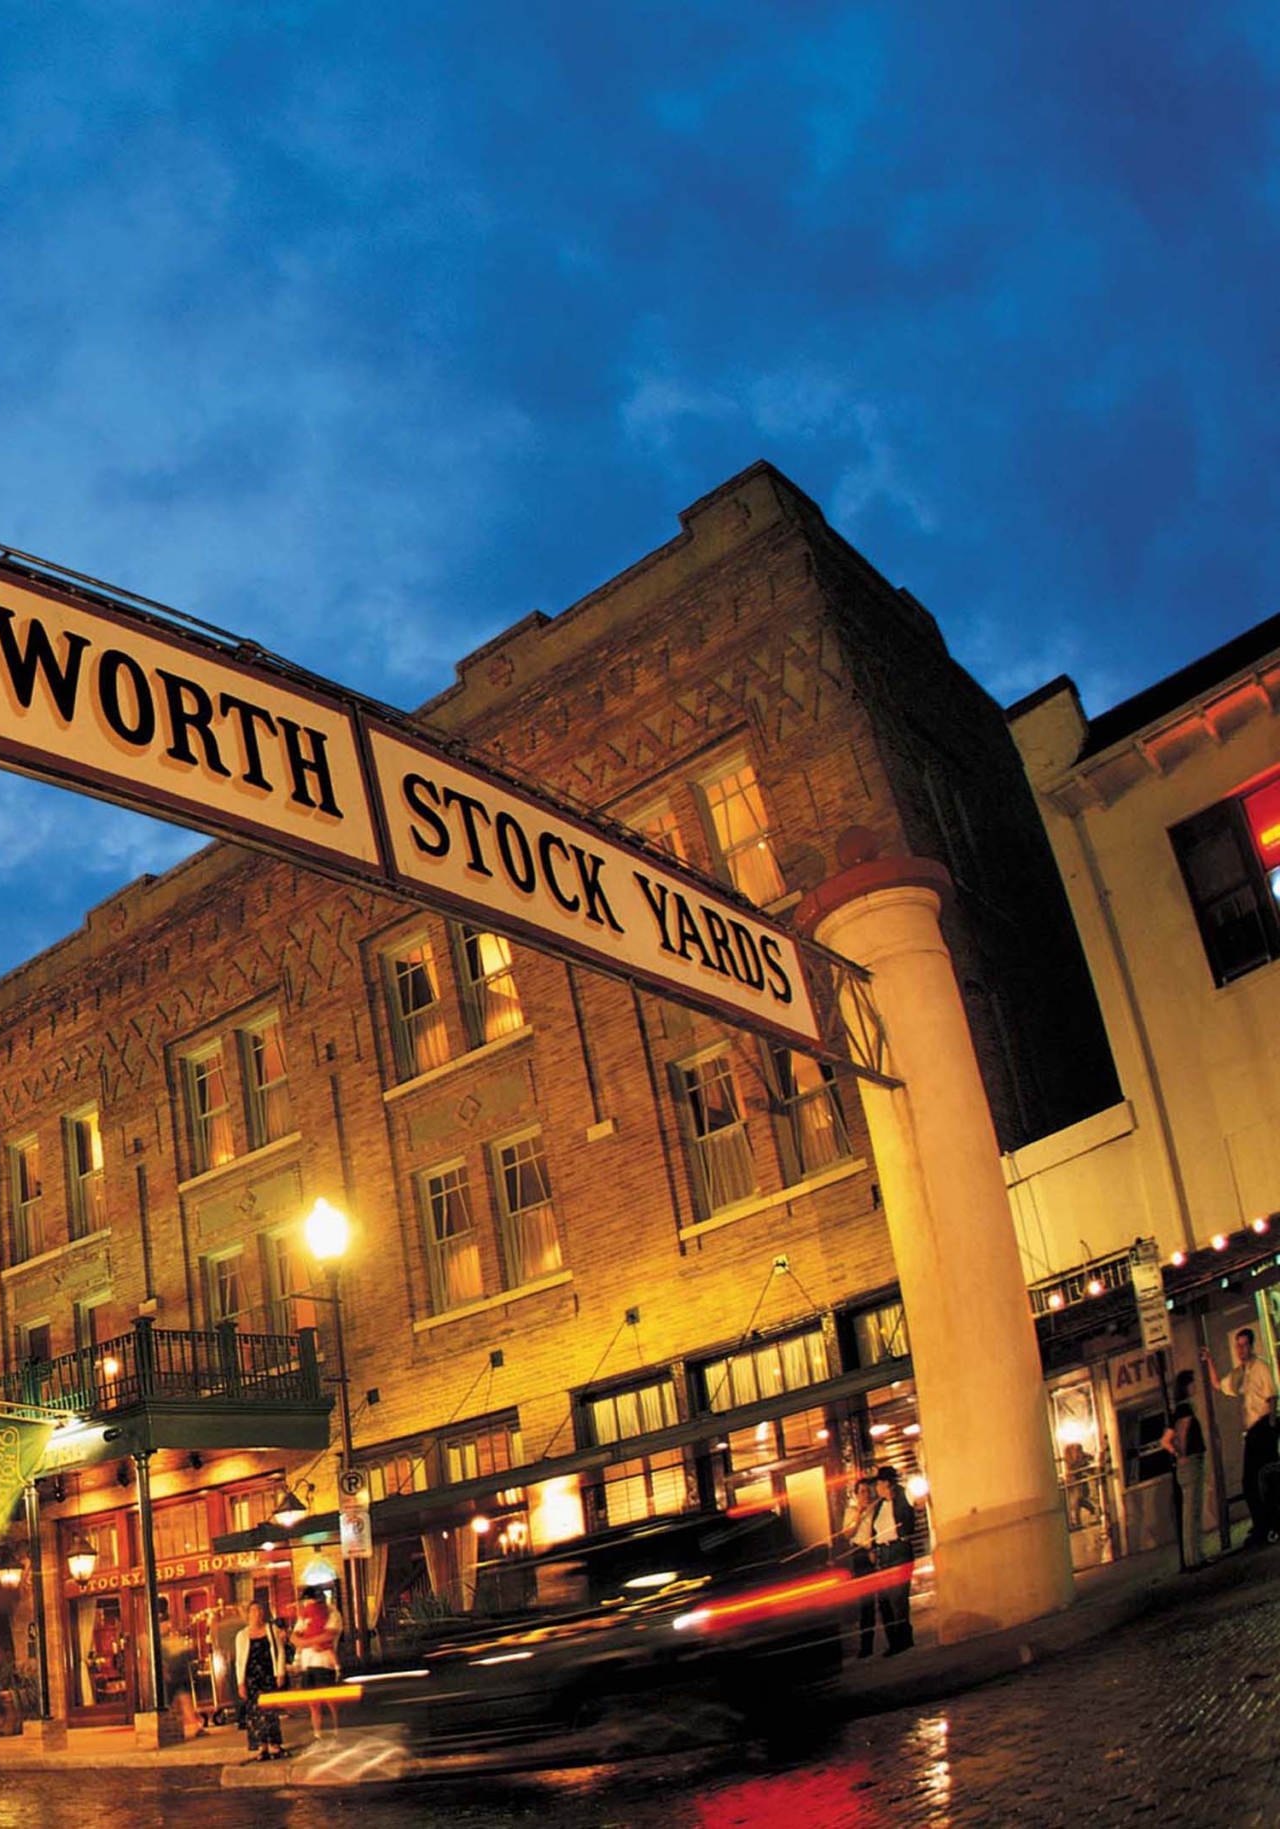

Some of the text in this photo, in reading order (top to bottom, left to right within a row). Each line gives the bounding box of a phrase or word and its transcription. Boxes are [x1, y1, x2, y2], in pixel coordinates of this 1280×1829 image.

[402, 772, 793, 1005] STOCK YARDS
[79, 1564, 186, 1593] STOCKYRDS
